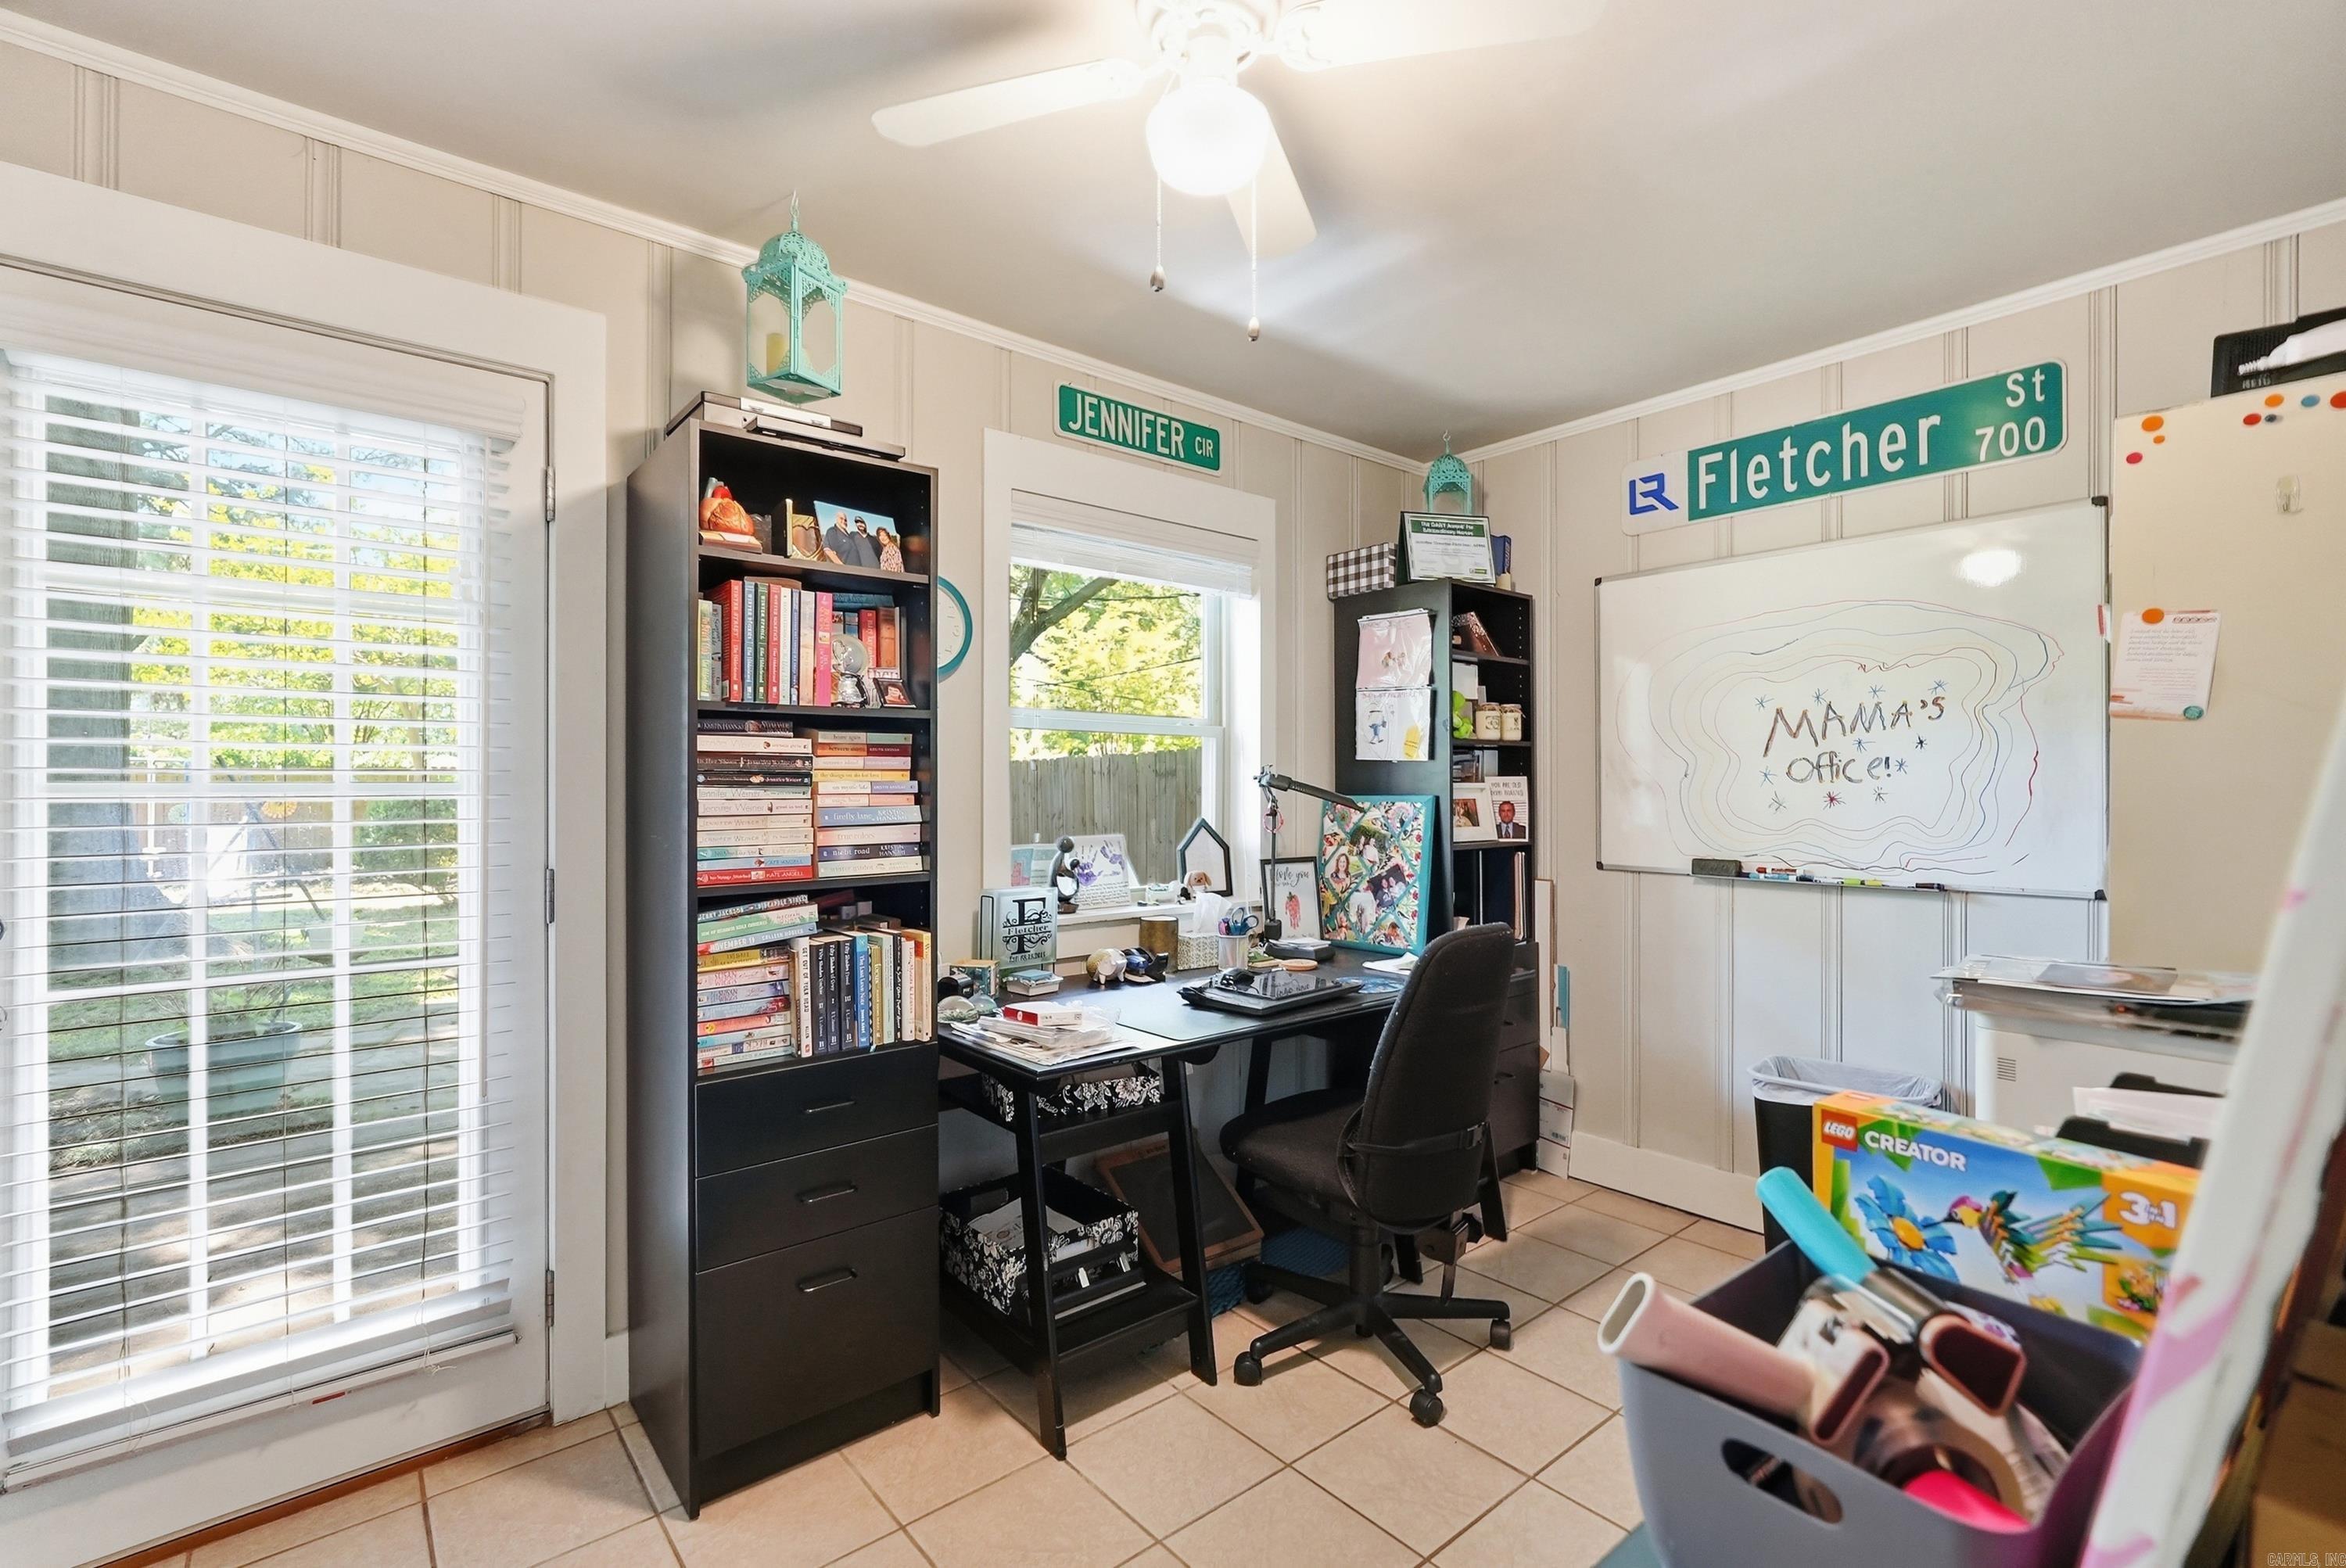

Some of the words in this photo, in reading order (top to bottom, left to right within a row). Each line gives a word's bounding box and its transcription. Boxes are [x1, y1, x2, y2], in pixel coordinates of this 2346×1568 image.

[2006, 368, 2046, 407] St
[1068, 393, 1184, 458] JENNIFER
[1195, 436, 1213, 457] CIR
[1698, 414, 1942, 510] Fletcher
[1975, 416, 2046, 462] 700
[1763, 696, 1946, 758] MAMA'S
[1008, 925, 1049, 935] Fletcher
[1824, 1121, 1856, 1140] LEGO
[1864, 1131, 1967, 1172] CREATOR
